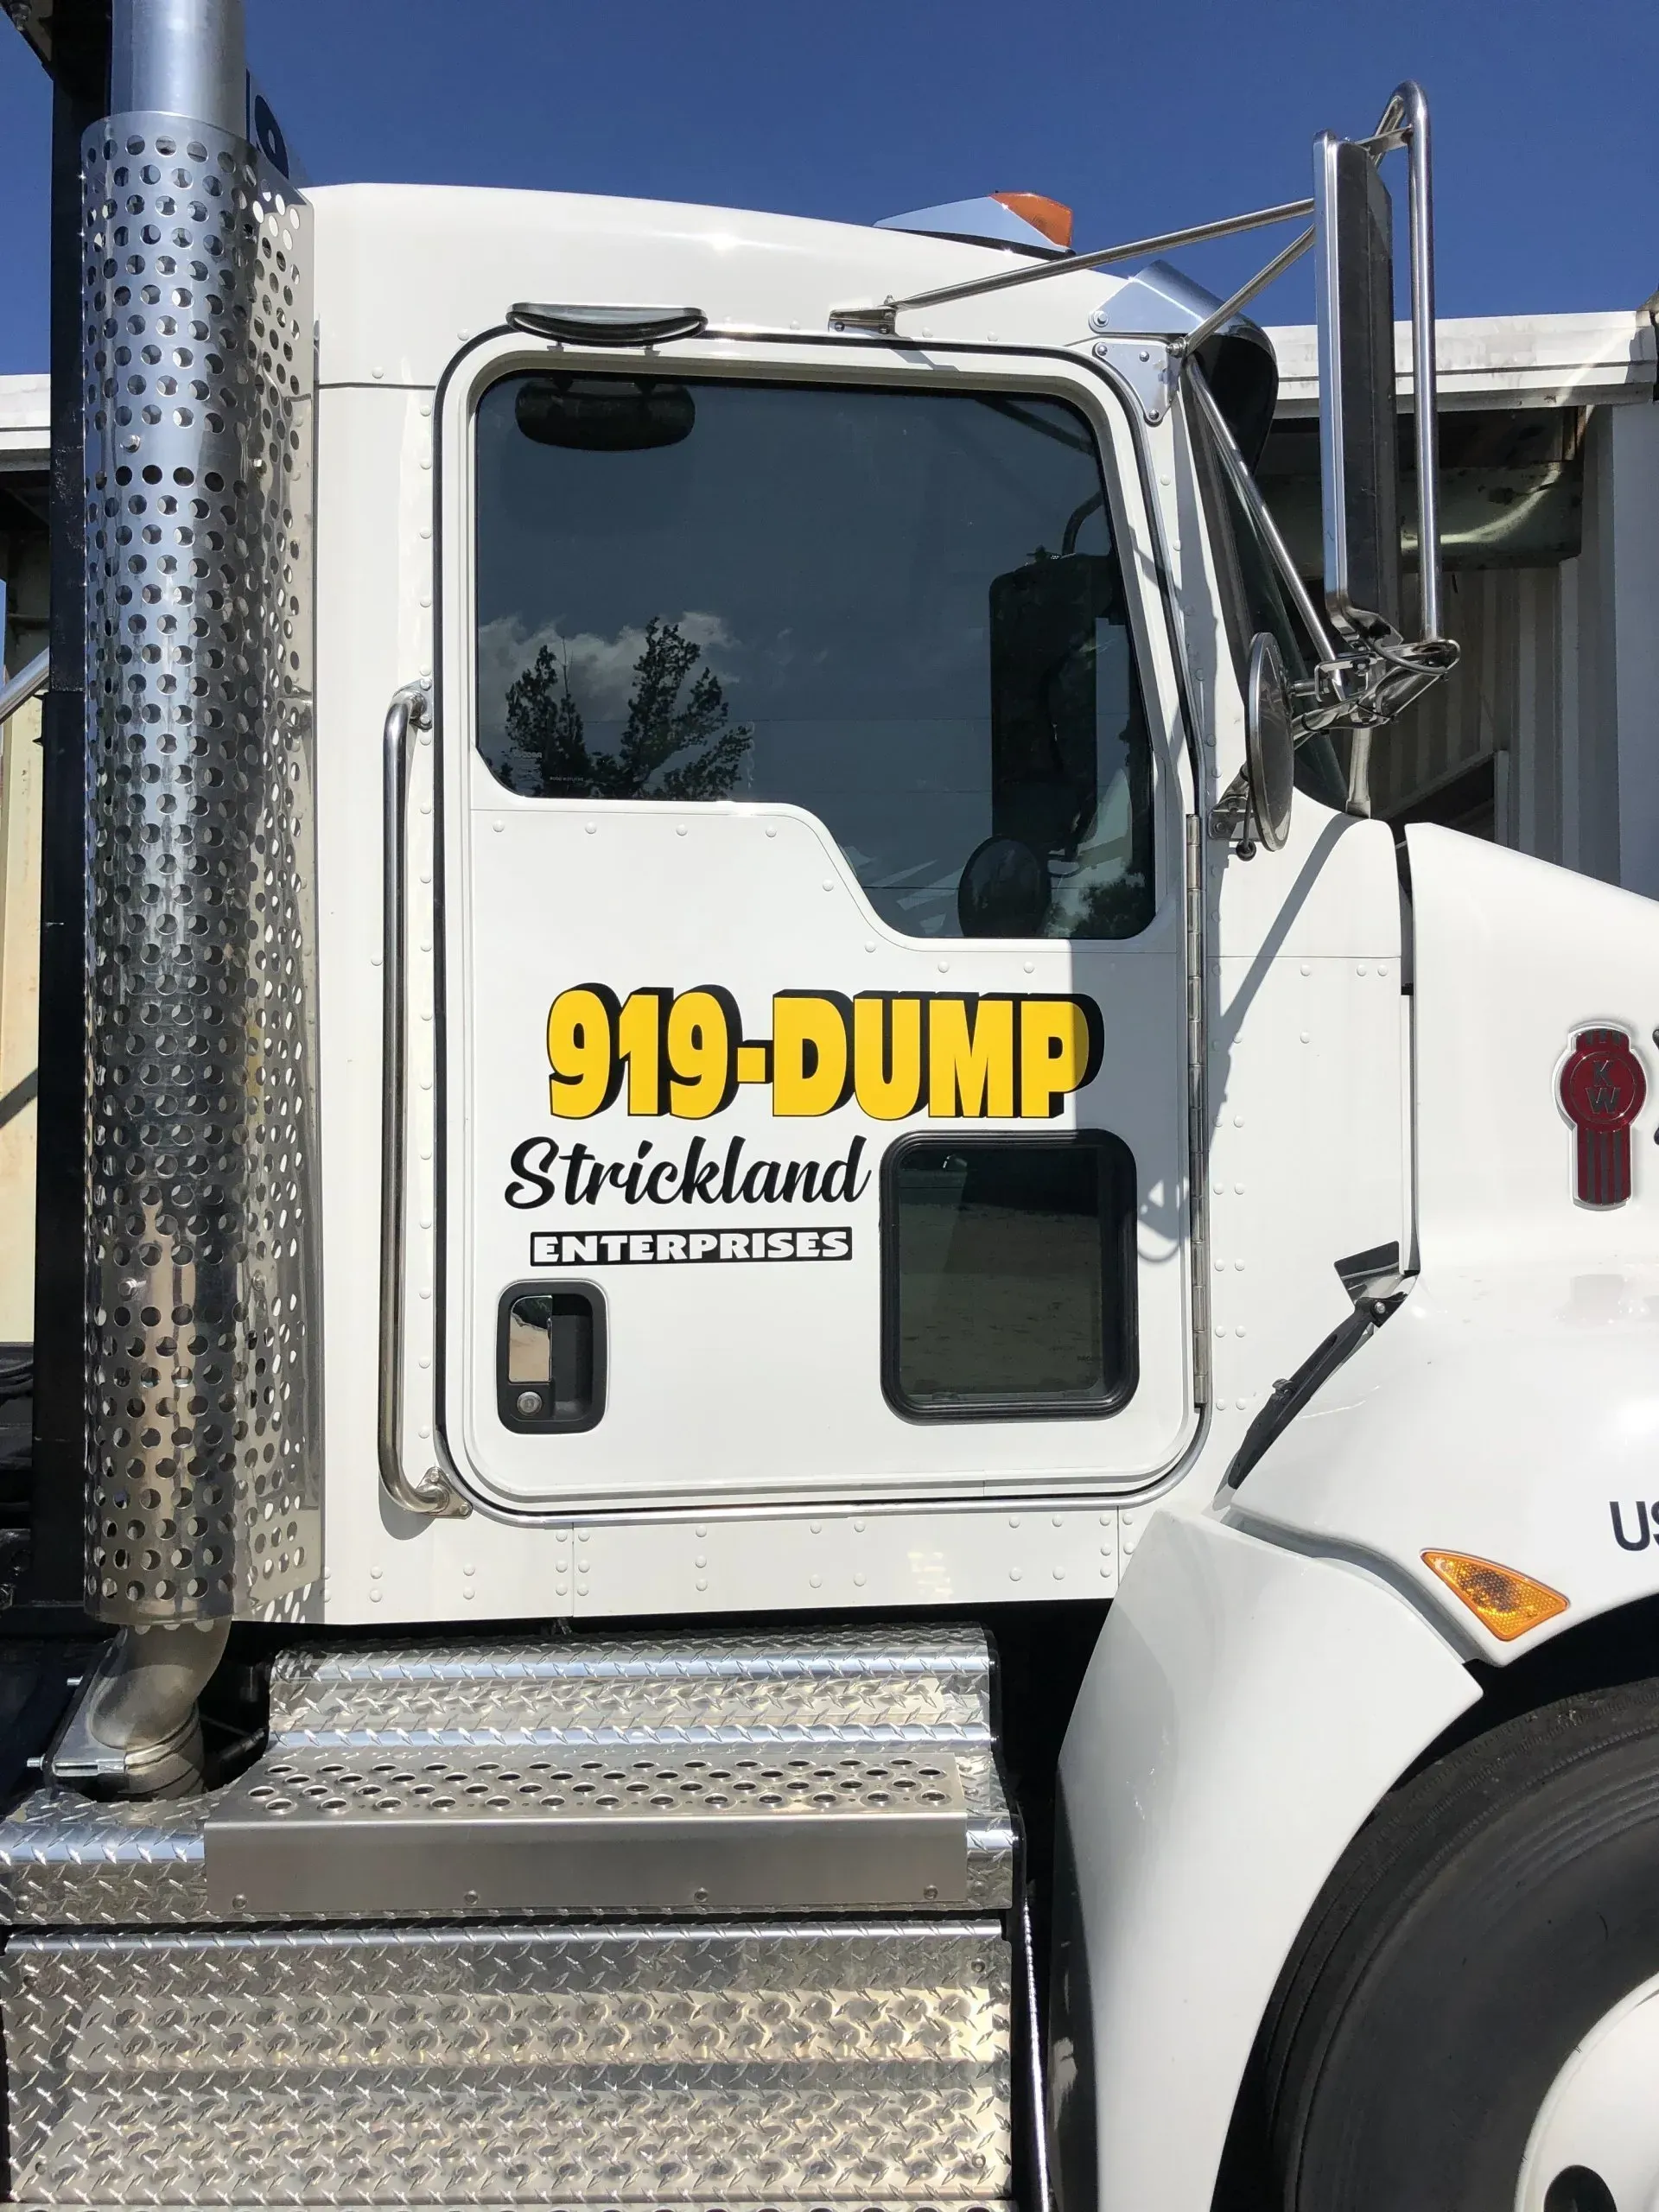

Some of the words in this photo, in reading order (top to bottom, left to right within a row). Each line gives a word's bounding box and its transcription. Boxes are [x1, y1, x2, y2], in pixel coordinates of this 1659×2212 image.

[547, 983, 1105, 1122] 919-DUMP
[505, 1135, 872, 1210] Strickland
[532, 1230, 850, 1263] ENTERPRISES
